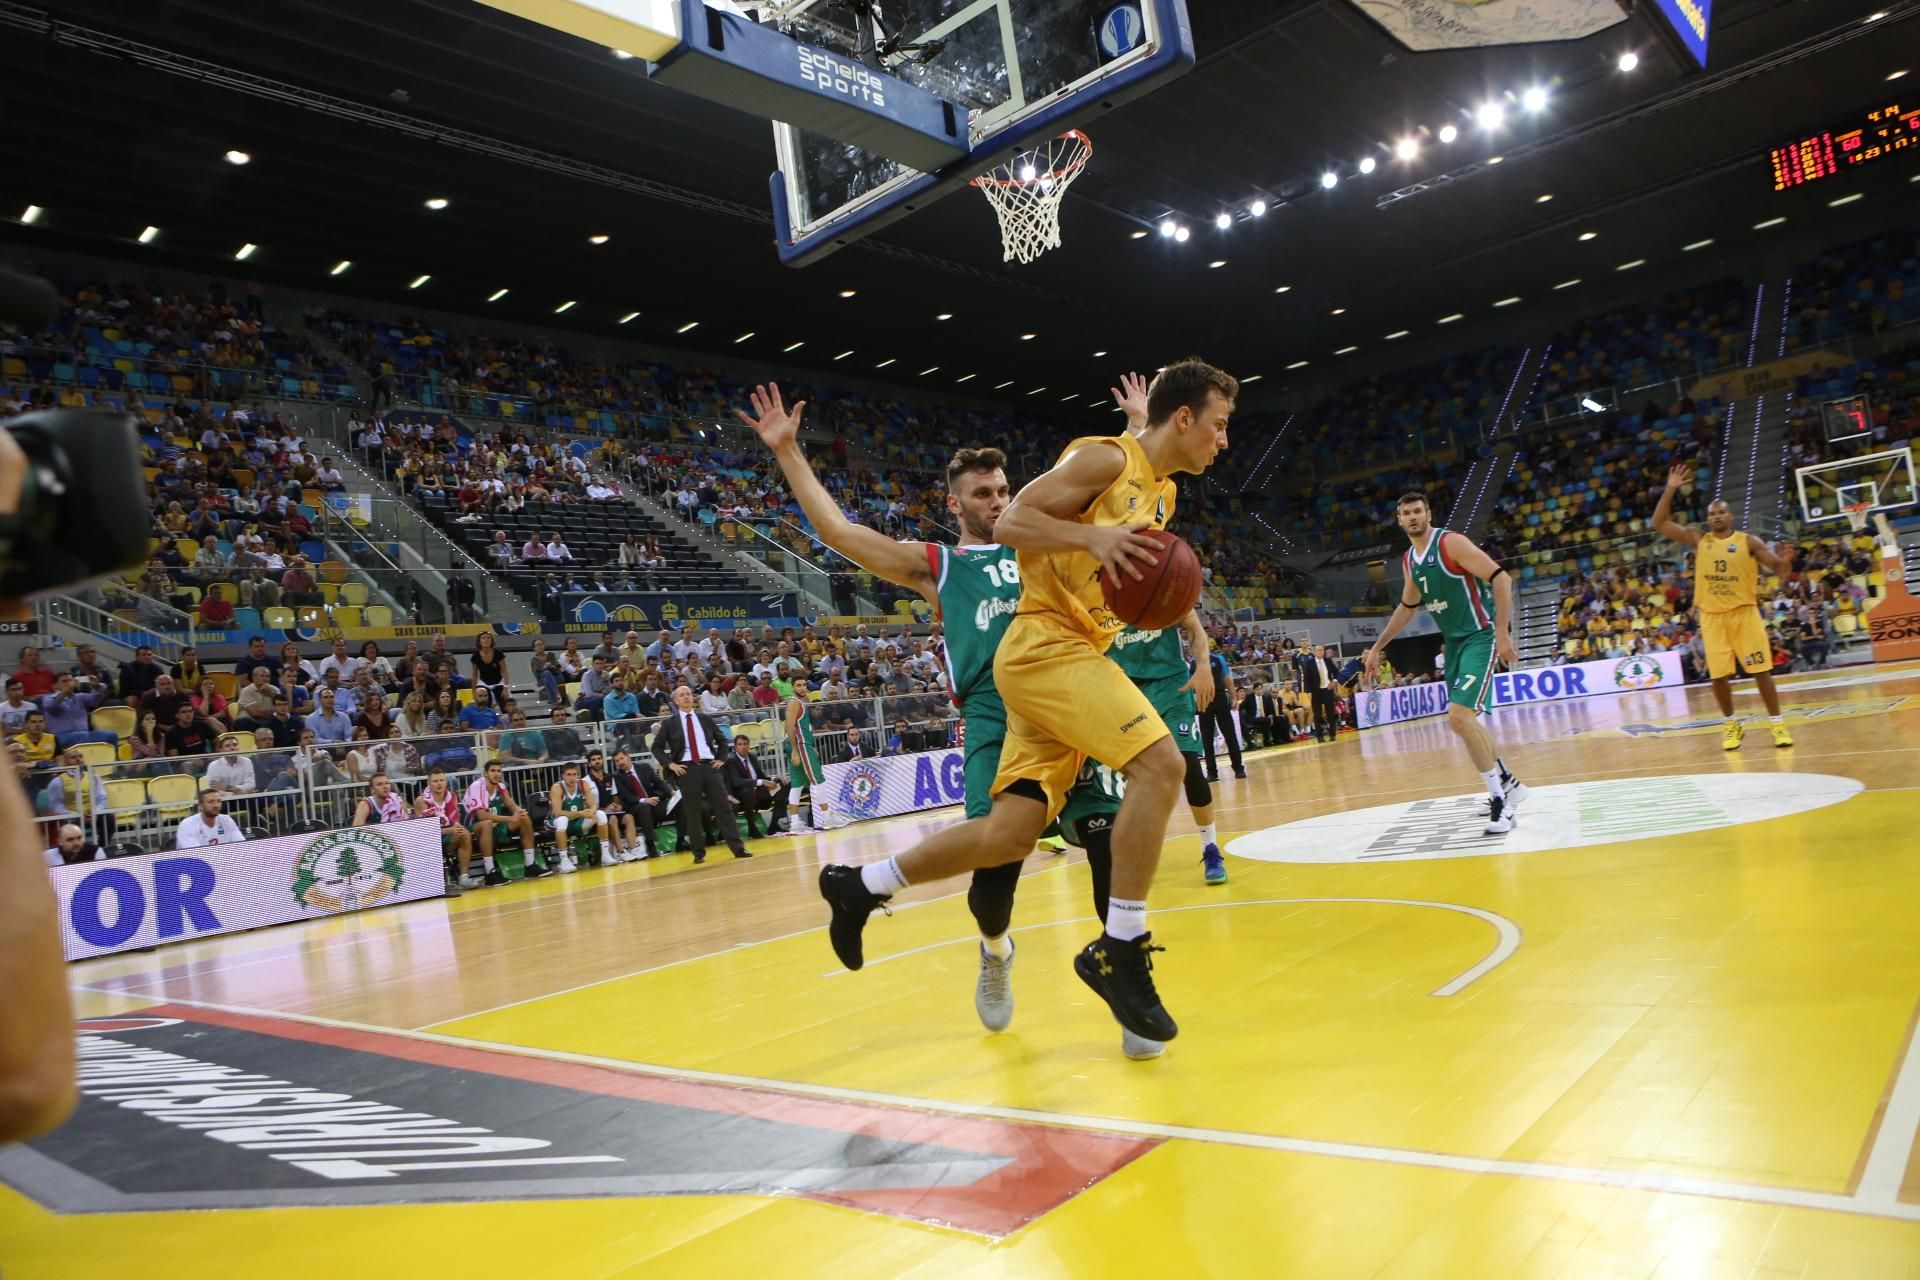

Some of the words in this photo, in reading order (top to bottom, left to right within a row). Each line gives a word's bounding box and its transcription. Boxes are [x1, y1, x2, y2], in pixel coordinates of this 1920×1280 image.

[797, 45, 883, 91] Schelde
[800, 62, 885, 107] Sports
[983, 559, 1020, 587] 18
[1714, 560, 1727, 573] 13
[1419, 576, 1429, 594] 7
[687, 606, 731, 619] Cabildo
[733, 605, 747, 618] de
[1750, 652, 1764, 664] 13
[1461, 674, 1477, 691] 7
[1390, 685, 1435, 720] AGUAS
[914, 754, 965, 806] AG
[71, 857, 223, 947] OR
[85, 1080, 627, 1180] TURKISH
